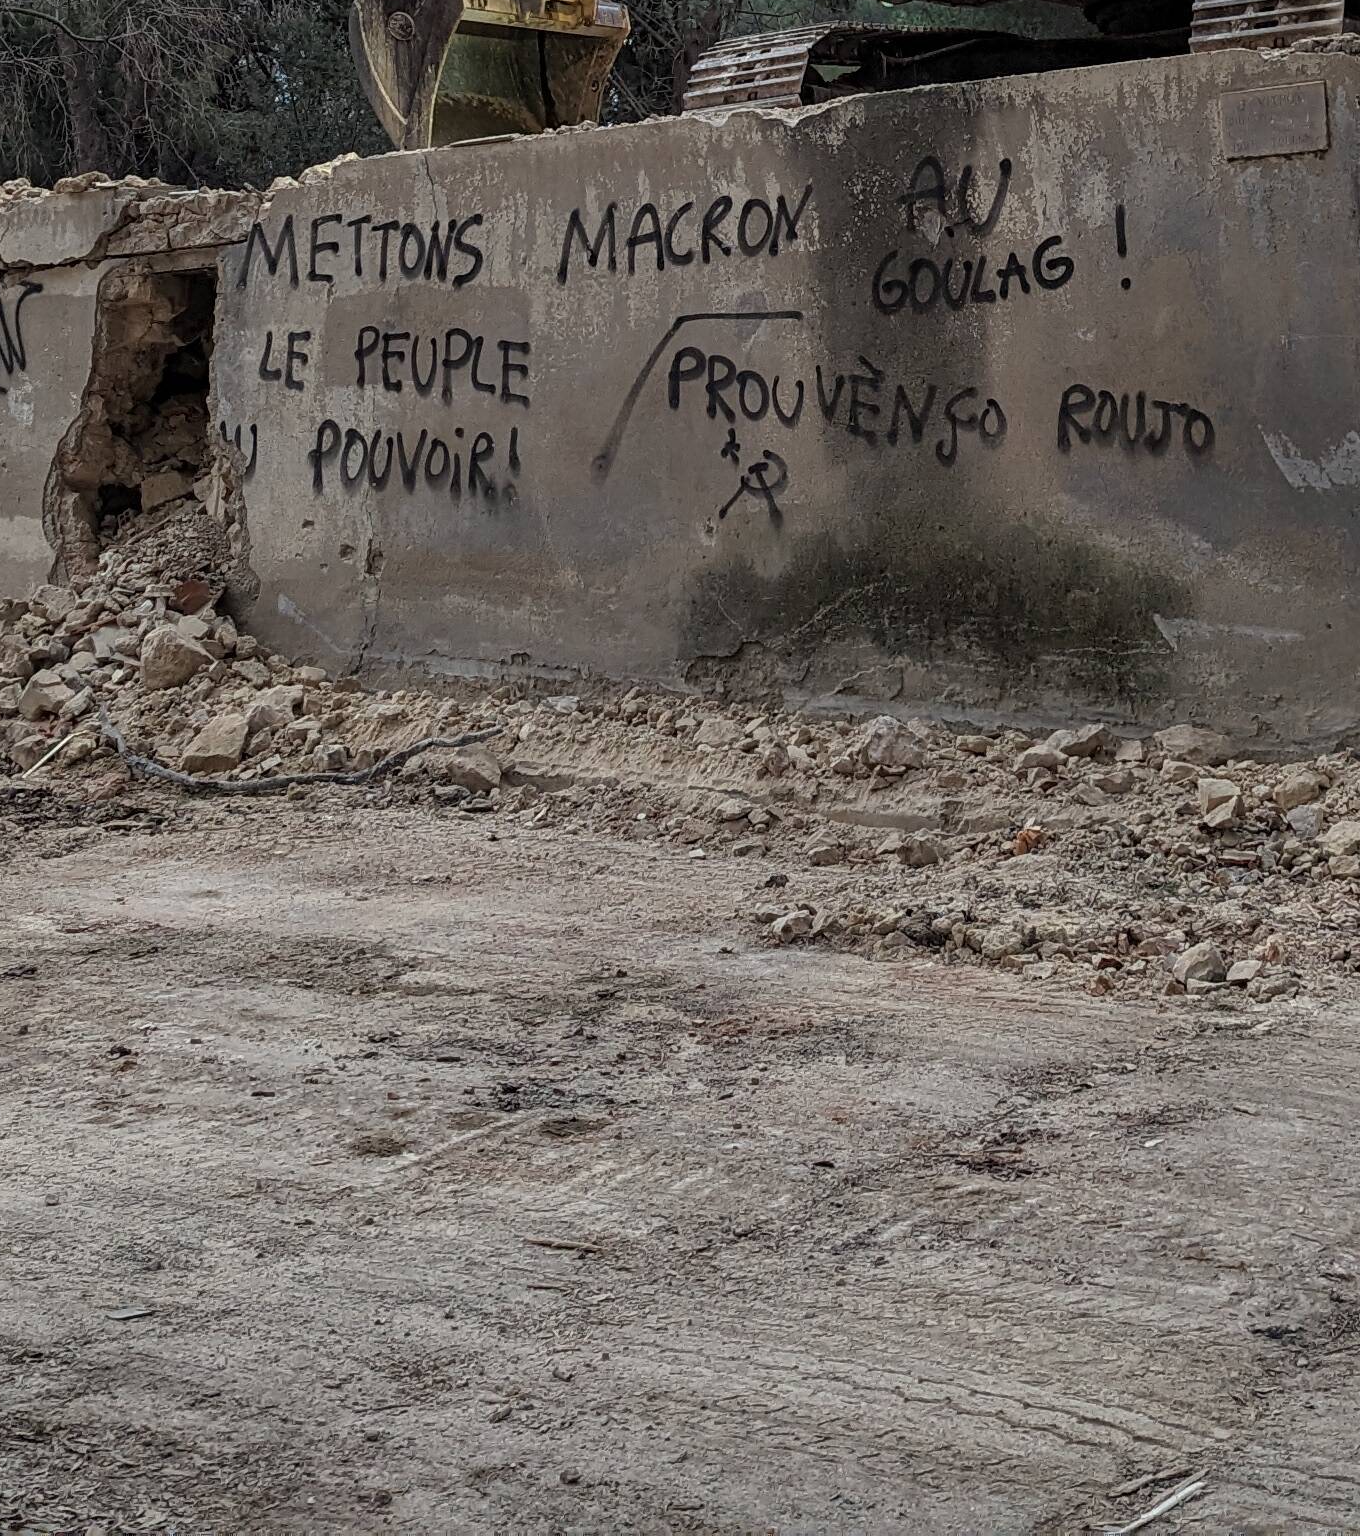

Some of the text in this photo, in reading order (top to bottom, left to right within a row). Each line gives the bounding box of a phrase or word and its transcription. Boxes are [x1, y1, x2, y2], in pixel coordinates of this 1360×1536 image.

[237, 178, 813, 289] METTONS MACRON
[895, 155, 1012, 238] AU
[871, 235, 1075, 314] GOULAG
[258, 325, 531, 407] LE PEUPLE
[220, 420, 258, 481] U
[1057, 383, 1216, 457] ROUJO
